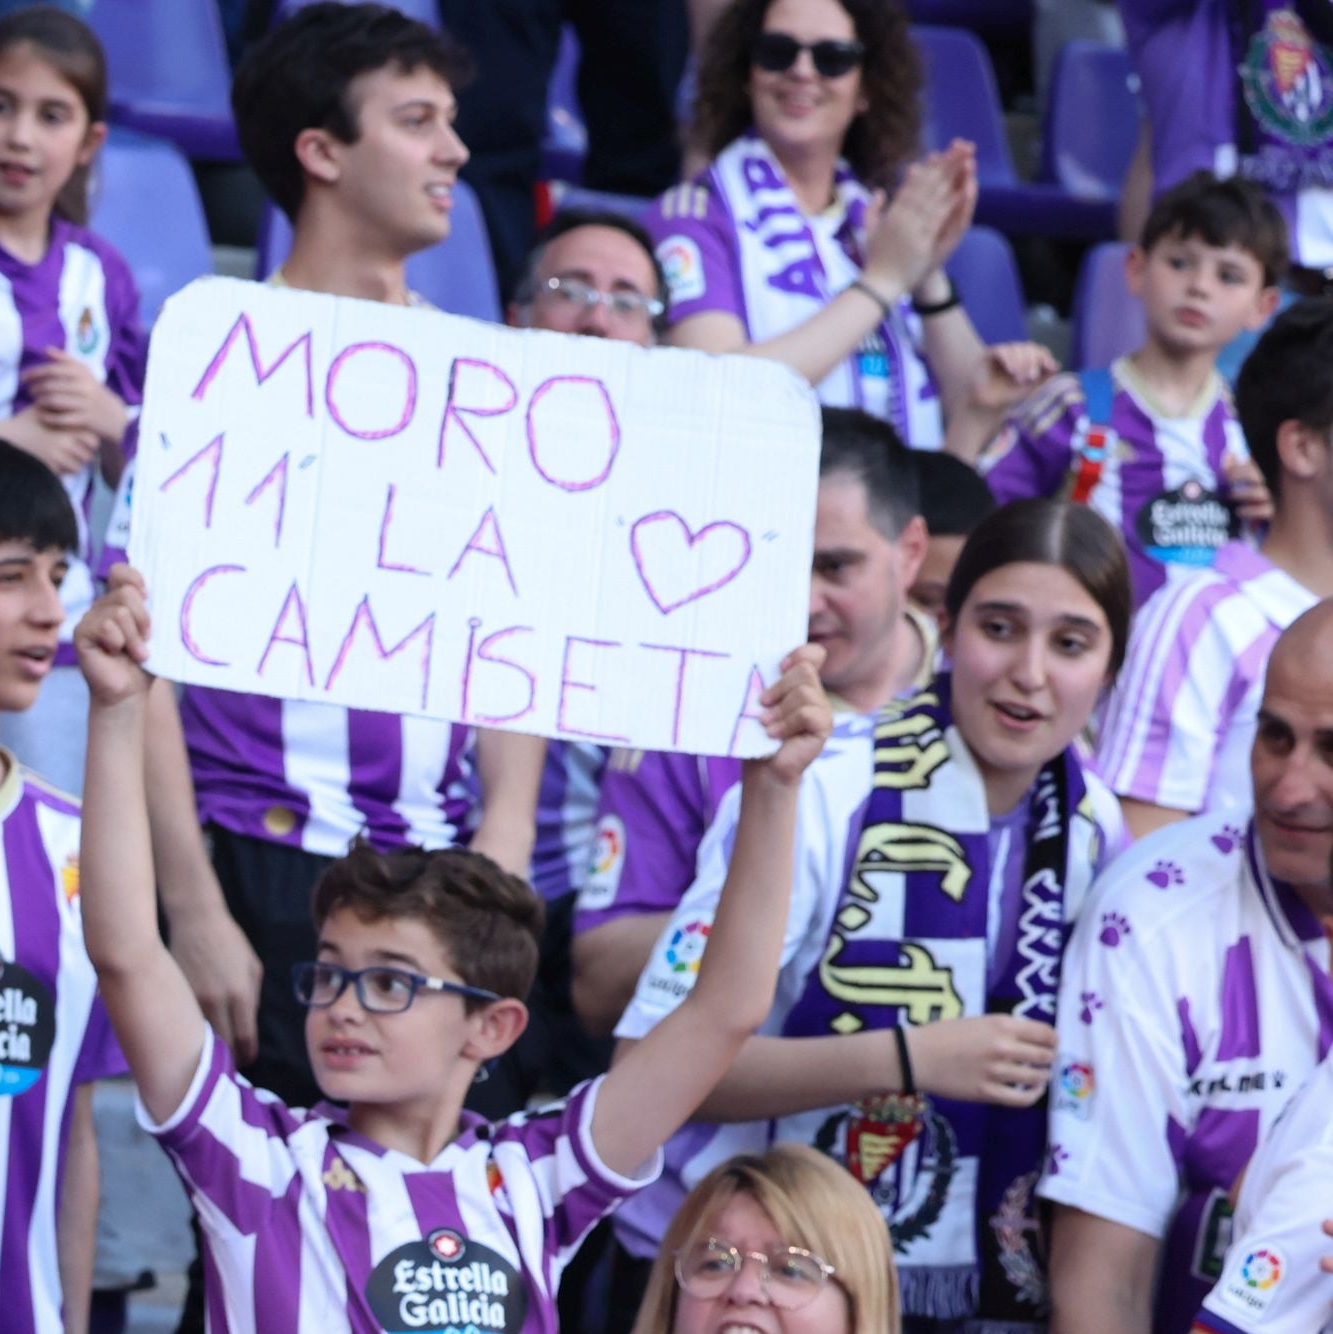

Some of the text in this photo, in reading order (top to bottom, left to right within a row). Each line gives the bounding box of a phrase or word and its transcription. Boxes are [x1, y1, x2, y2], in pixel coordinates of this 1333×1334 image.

[191, 312, 621, 491] MORO
[378, 483, 519, 597] LA
[392, 1259, 509, 1297] Estrella
[399, 1290, 506, 1329] Galicia
